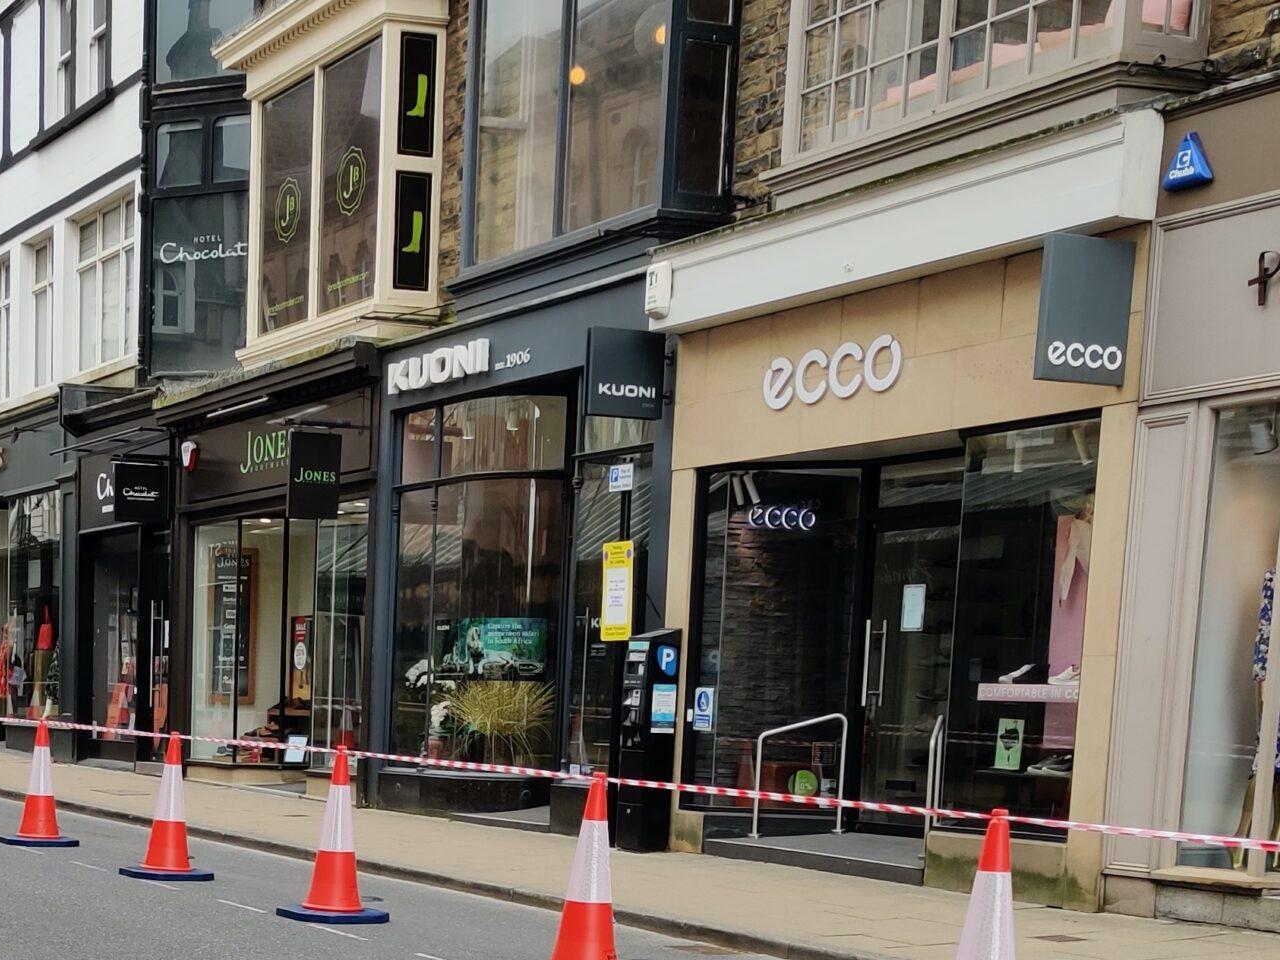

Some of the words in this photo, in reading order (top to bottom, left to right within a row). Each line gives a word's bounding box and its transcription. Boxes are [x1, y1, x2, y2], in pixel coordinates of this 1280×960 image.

[193, 234, 222, 244] HOTEL
[160, 242, 248, 264] Chocolat
[1047, 340, 1123, 371] ecco
[387, 338, 490, 396] KUONI
[506, 348, 531, 368] 1906
[763, 334, 902, 411] ecco
[598, 382, 656, 399] KUONI
[294, 467, 337, 482] JONES
[748, 506, 816, 531] ecco
[661, 648, 675, 671] P
[979, 686, 1048, 698] COMFORTABLE
[1050, 687, 1062, 699] IN
